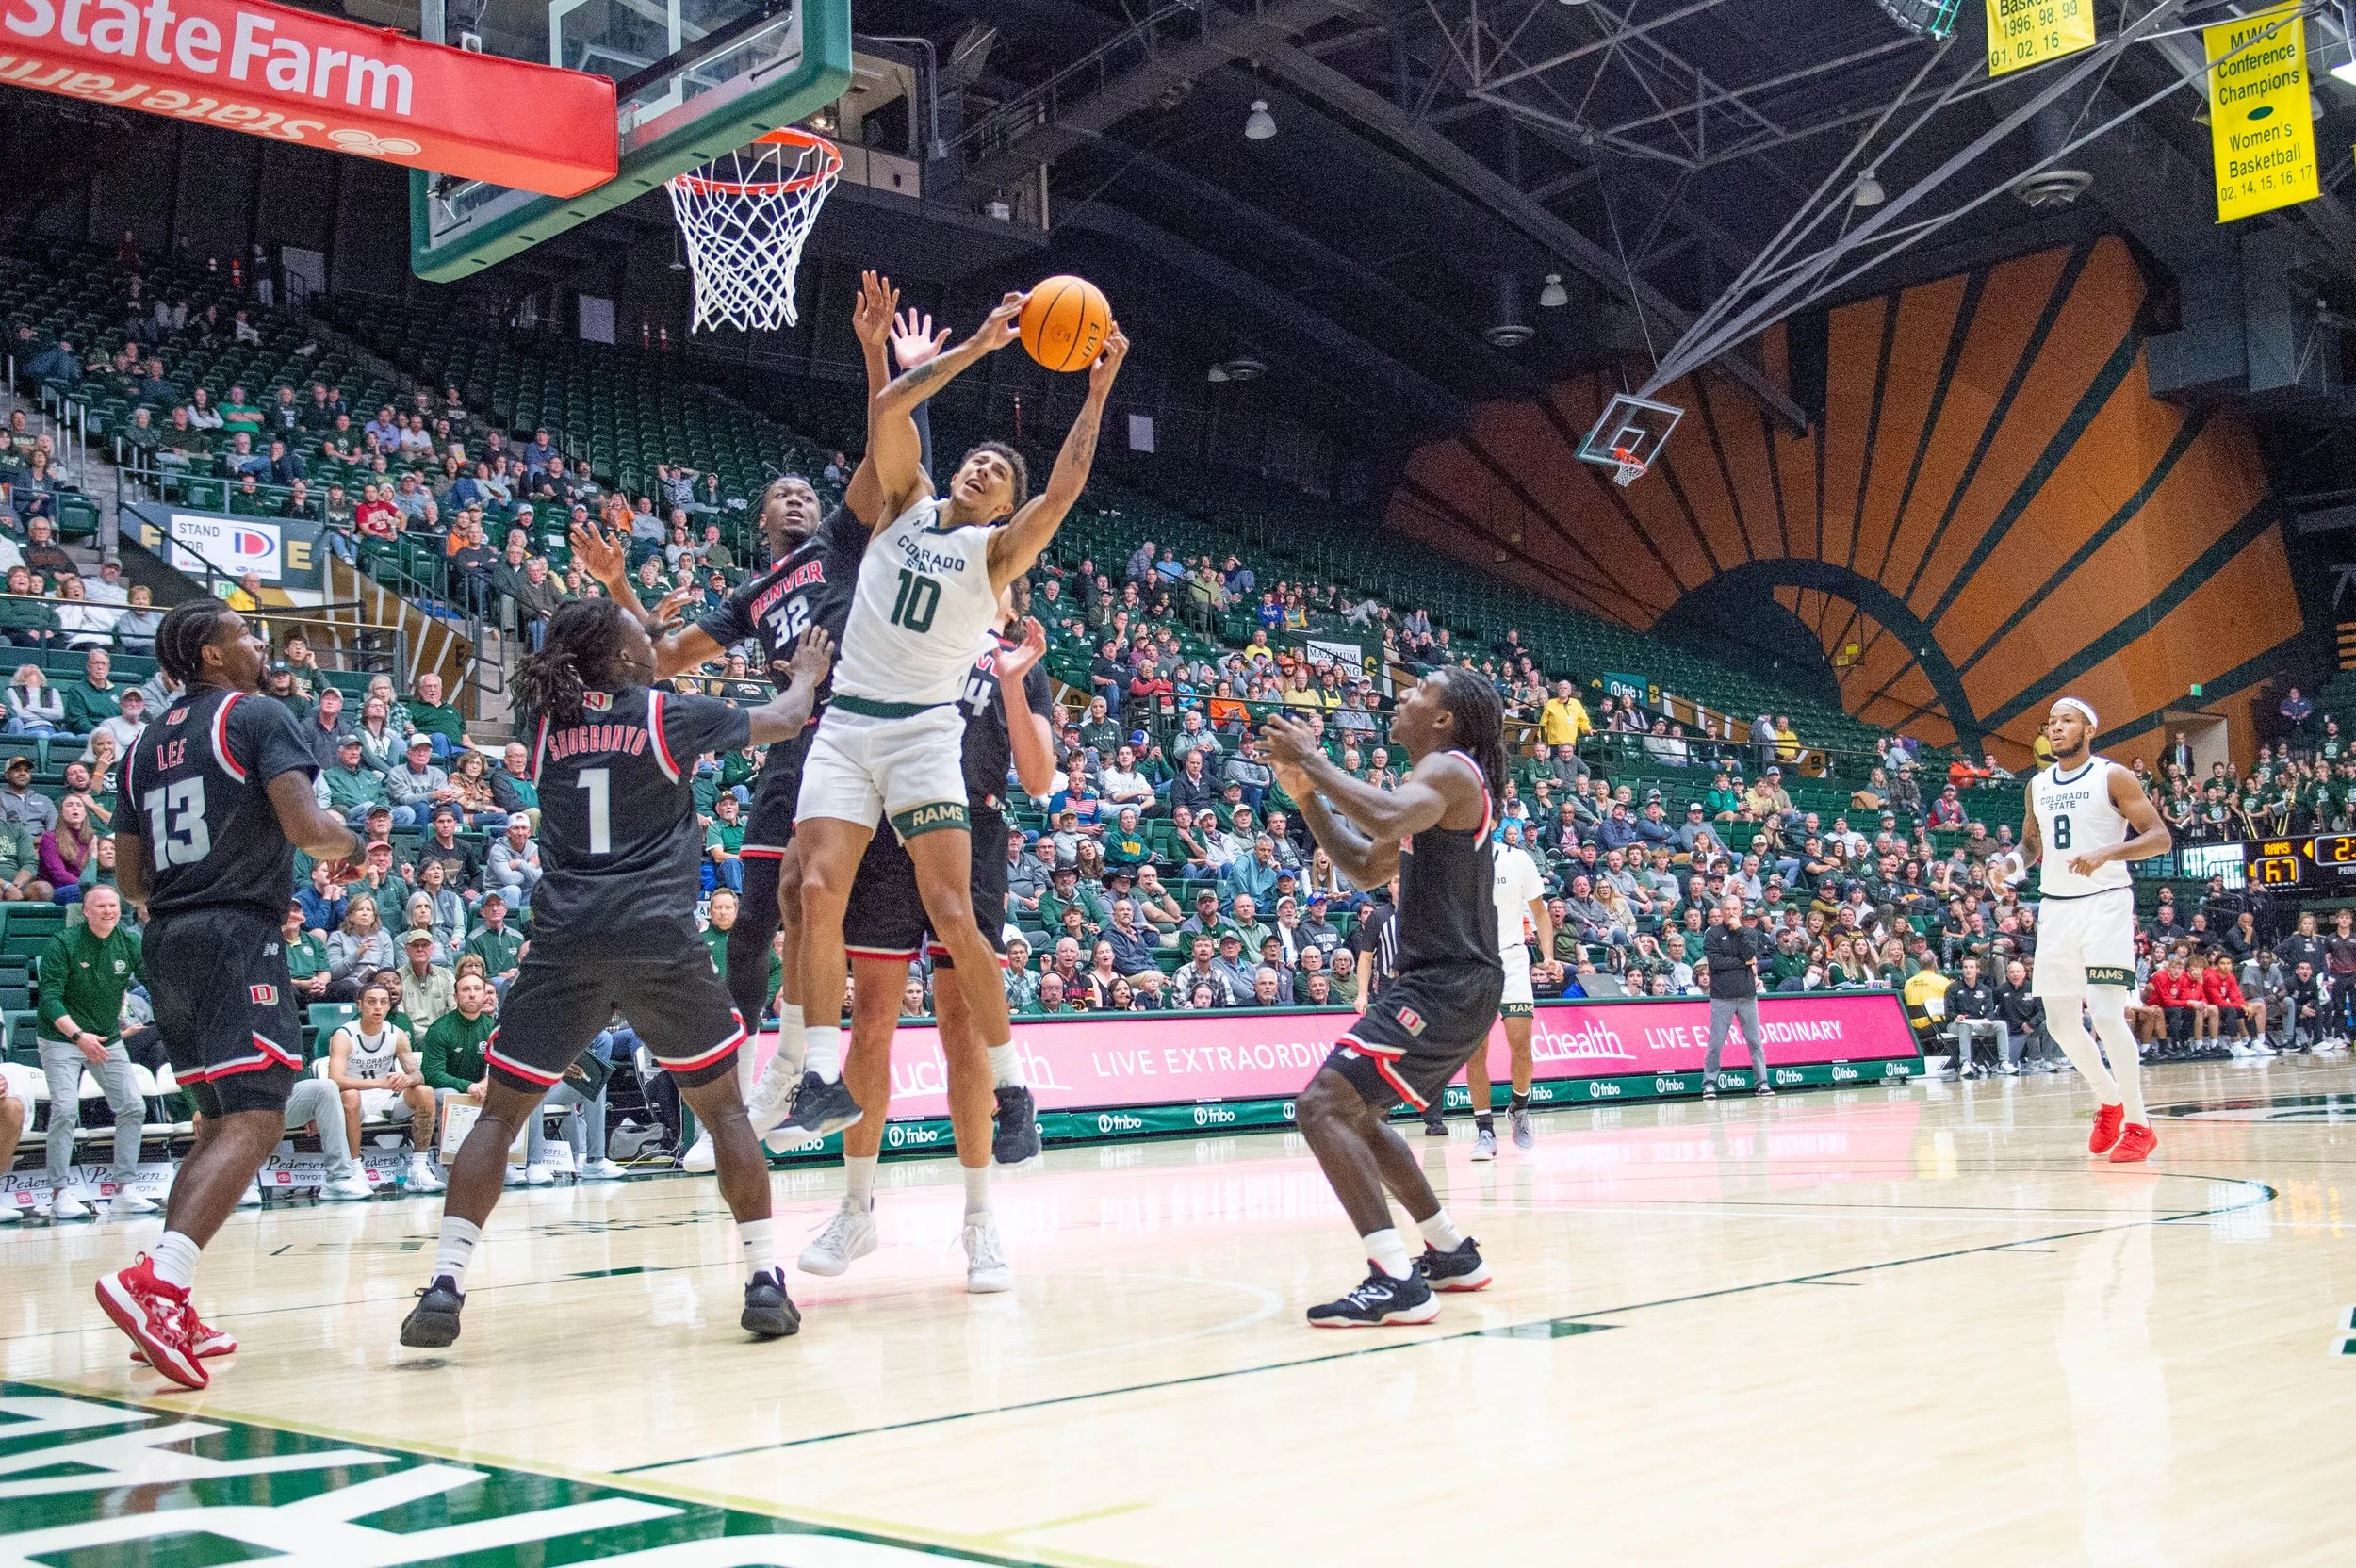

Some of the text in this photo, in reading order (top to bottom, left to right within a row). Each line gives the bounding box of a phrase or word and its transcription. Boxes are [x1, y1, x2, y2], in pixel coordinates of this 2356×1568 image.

[2062, 2, 2078, 18] 99
[2043, 31, 2059, 51] 16
[4, 0, 413, 115] State Farm
[2217, 44, 2296, 79] Conference
[2219, 69, 2299, 106] Champions
[2229, 121, 2293, 152] Women's
[2229, 142, 2301, 179] Basketball
[2299, 165, 2313, 180] 17
[179, 522, 221, 537] STAND
[287, 540, 313, 570] E
[750, 559, 826, 629] DENVER
[890, 567, 941, 634] 10
[766, 595, 811, 649] 32
[547, 725, 648, 762] SHOGBONYO
[156, 738, 187, 771] LEE
[2040, 792, 2090, 806] COLORADO
[2048, 800, 2076, 810] STATE
[576, 767, 611, 855] 1
[912, 804, 965, 827] RAMS
[143, 776, 211, 873] 13
[2053, 814, 2071, 849] 8
[2264, 841, 2292, 856] RAMS
[2265, 858, 2297, 883] 67
[2338, 865, 2356, 875] PERI
[2088, 969, 2124, 981] RAMS
[1531, 1019, 1627, 1061] chealth
[1644, 1020, 1843, 1050] LIVE ERORDINARY
[351, 1055, 393, 1065] COLORADO
[1091, 1040, 1337, 1078] LIVE EXTRAORDIN
[1727, 1074, 1745, 1086] fnbo
[1785, 1070, 1803, 1083] fnbo
[1841, 1067, 1857, 1079] fnbo
[1532, 1086, 1553, 1100] fnbo
[1600, 1083, 1621, 1096] fnbo
[1665, 1079, 1685, 1091] fnbo
[1113, 1114, 1142, 1129] fnbo
[1208, 1107, 1235, 1122] fnbo
[906, 1126, 938, 1143] fnbo
[87, 1167, 168, 1184] Pesen
